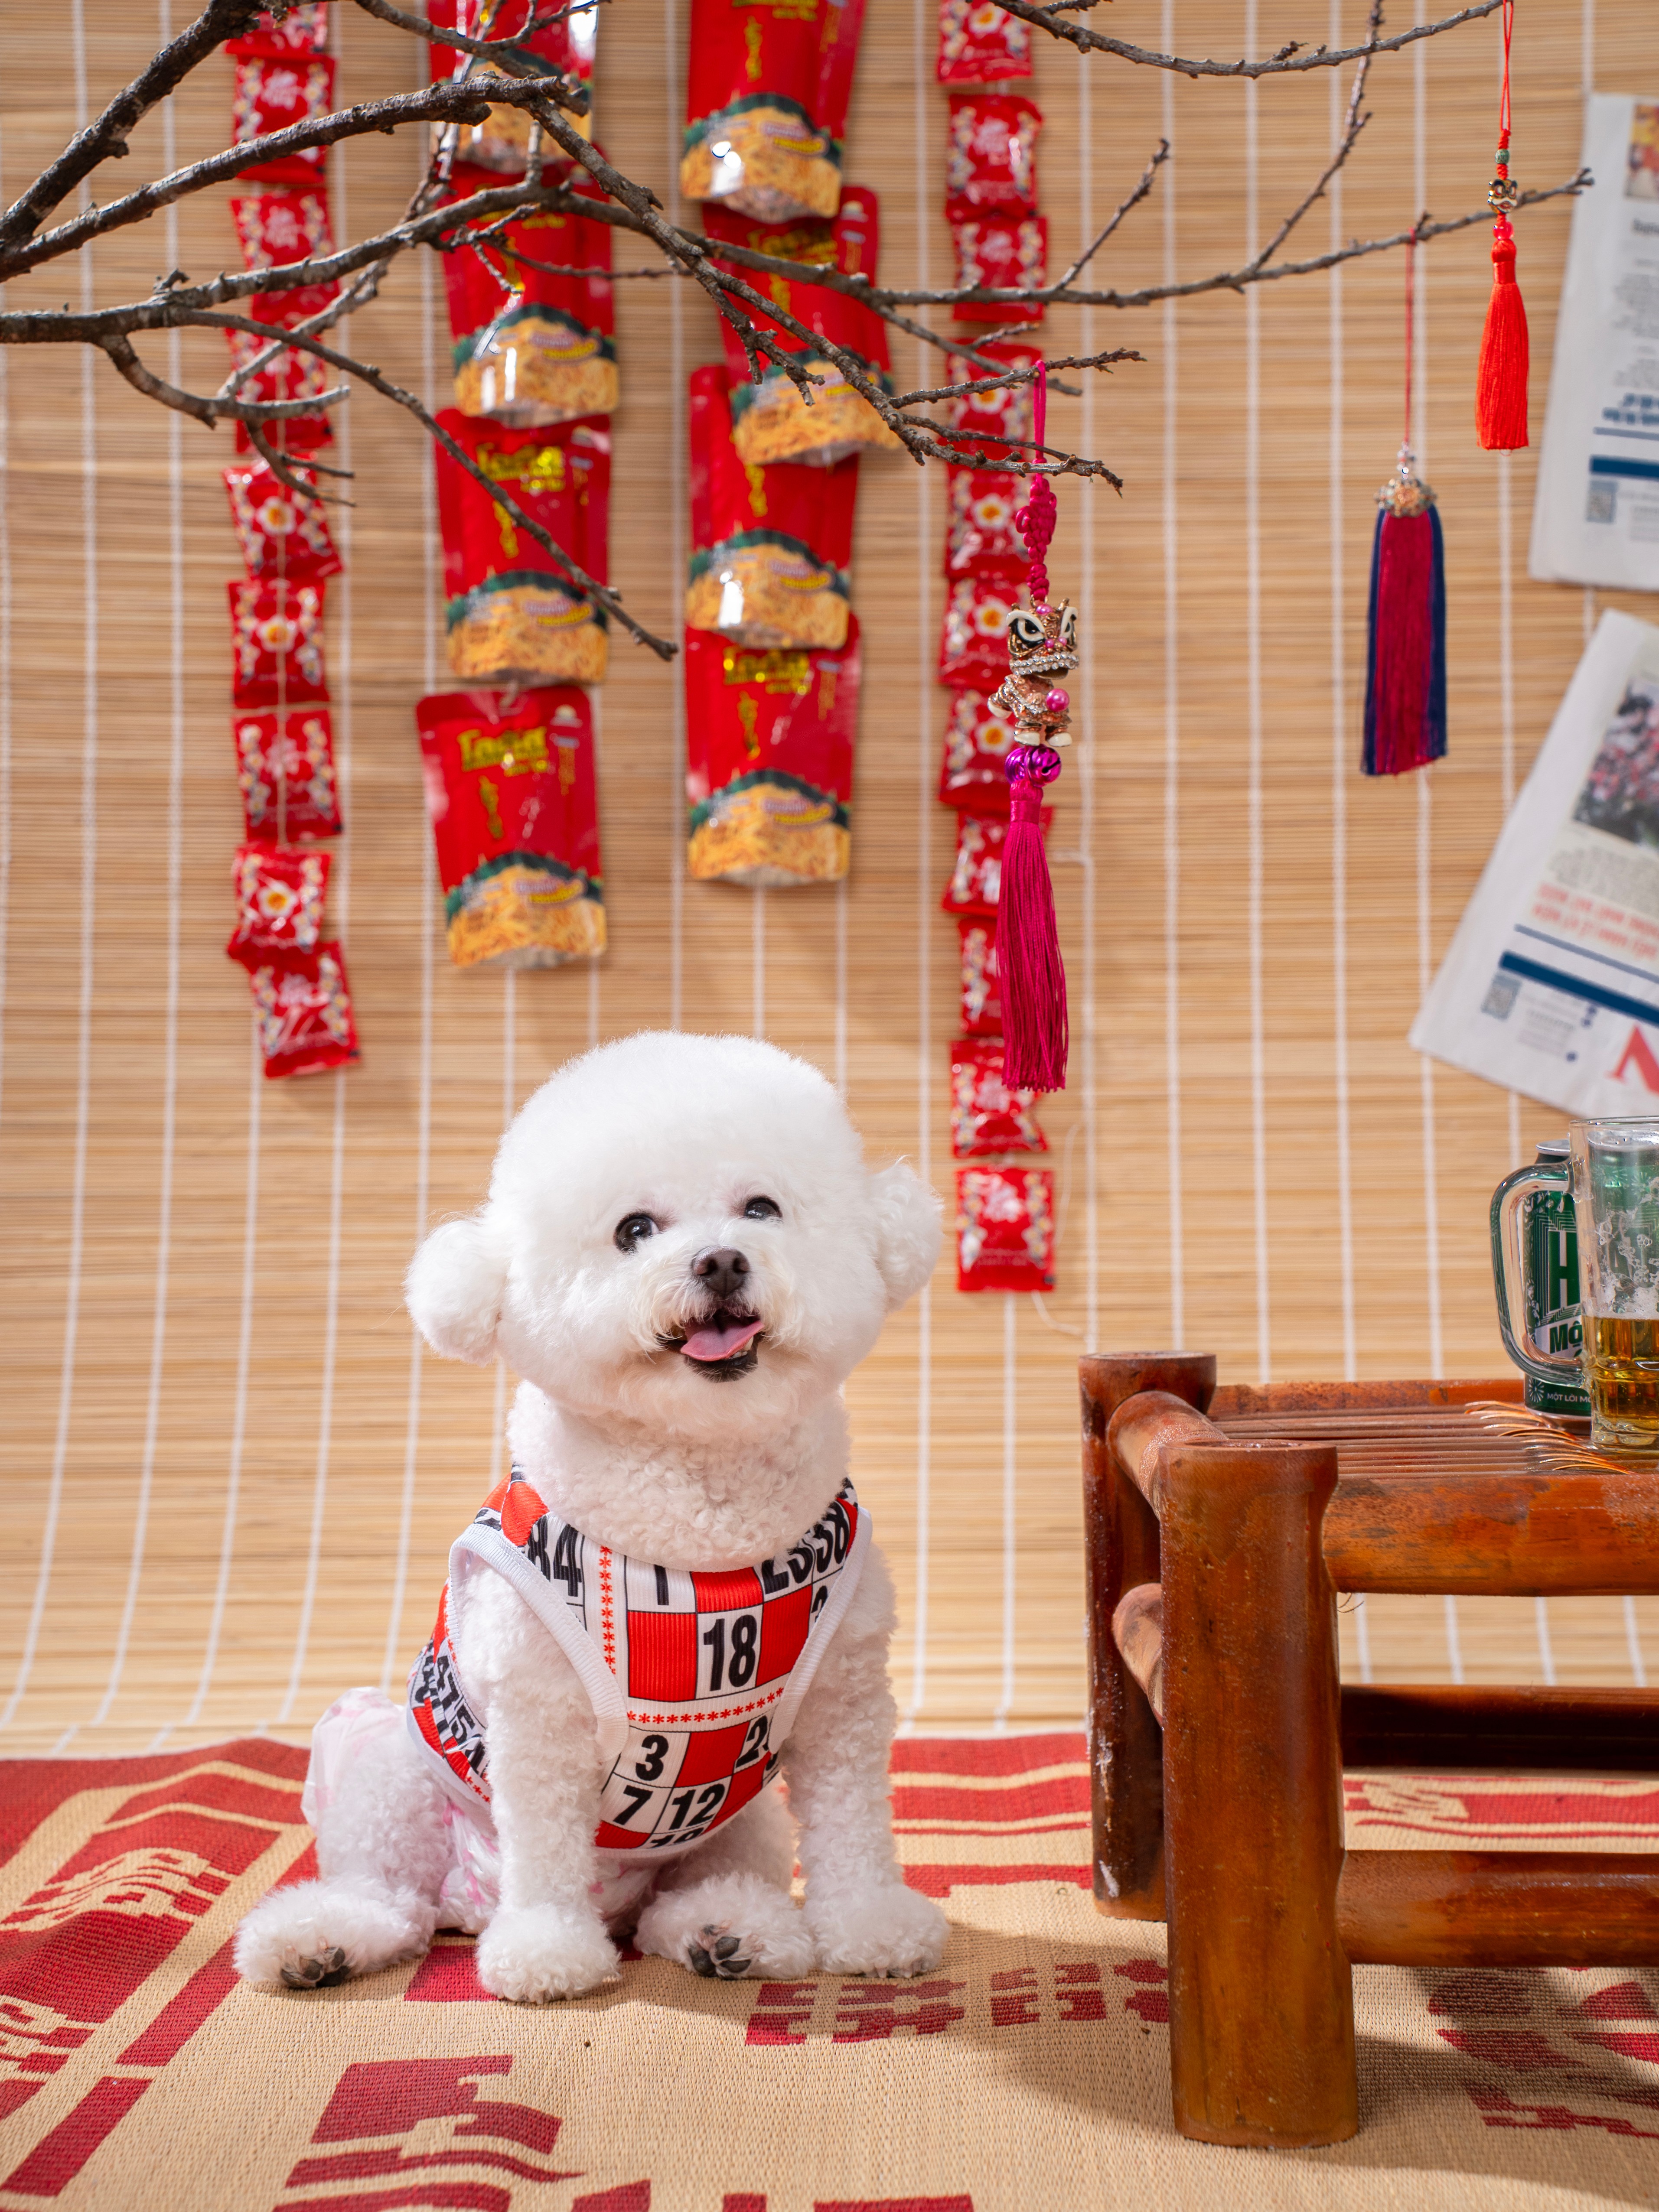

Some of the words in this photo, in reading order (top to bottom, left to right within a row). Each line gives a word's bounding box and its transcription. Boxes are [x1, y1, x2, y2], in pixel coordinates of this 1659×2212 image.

[1550, 1320, 1583, 1354] MỘ
[704, 1614, 757, 1692] 18
[636, 1734, 669, 1781] 3
[613, 1785, 653, 1825] 7
[668, 1783, 725, 1830] 12
